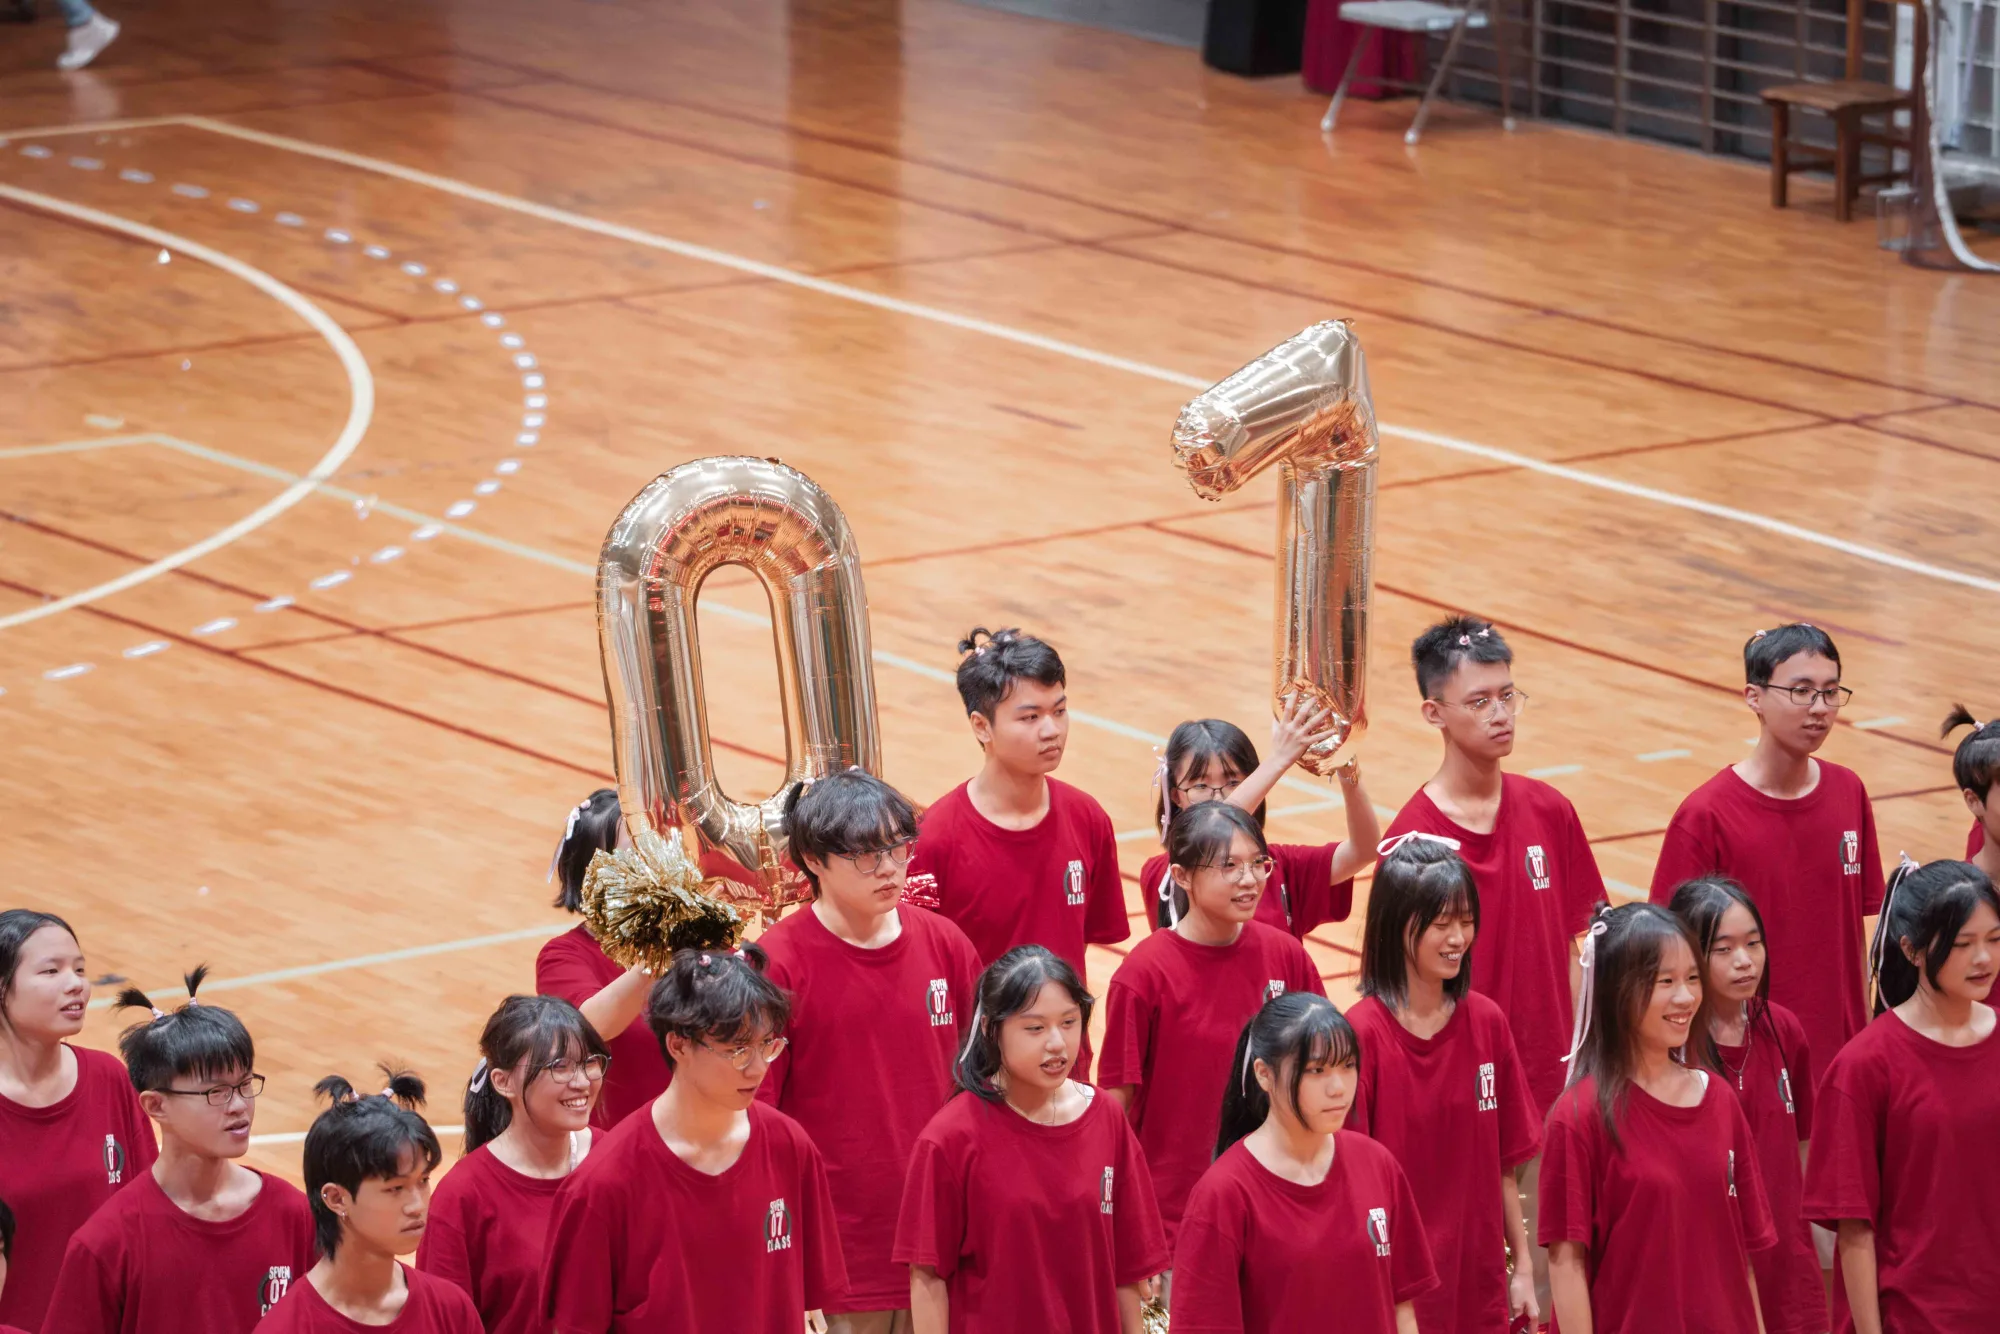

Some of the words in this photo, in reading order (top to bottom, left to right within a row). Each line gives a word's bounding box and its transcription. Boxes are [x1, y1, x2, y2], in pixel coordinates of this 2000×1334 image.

[1067, 892, 1085, 906] CLAS
[930, 978, 948, 992] SEVEN
[934, 990, 947, 1014] 07
[931, 1012, 953, 1026] CLASS
[1481, 1074, 1495, 1099] 07
[770, 1211, 784, 1238] 07
[767, 1234, 791, 1253] CLASS
[269, 1265, 291, 1280] SEVEN
[269, 1278, 289, 1304] 07
